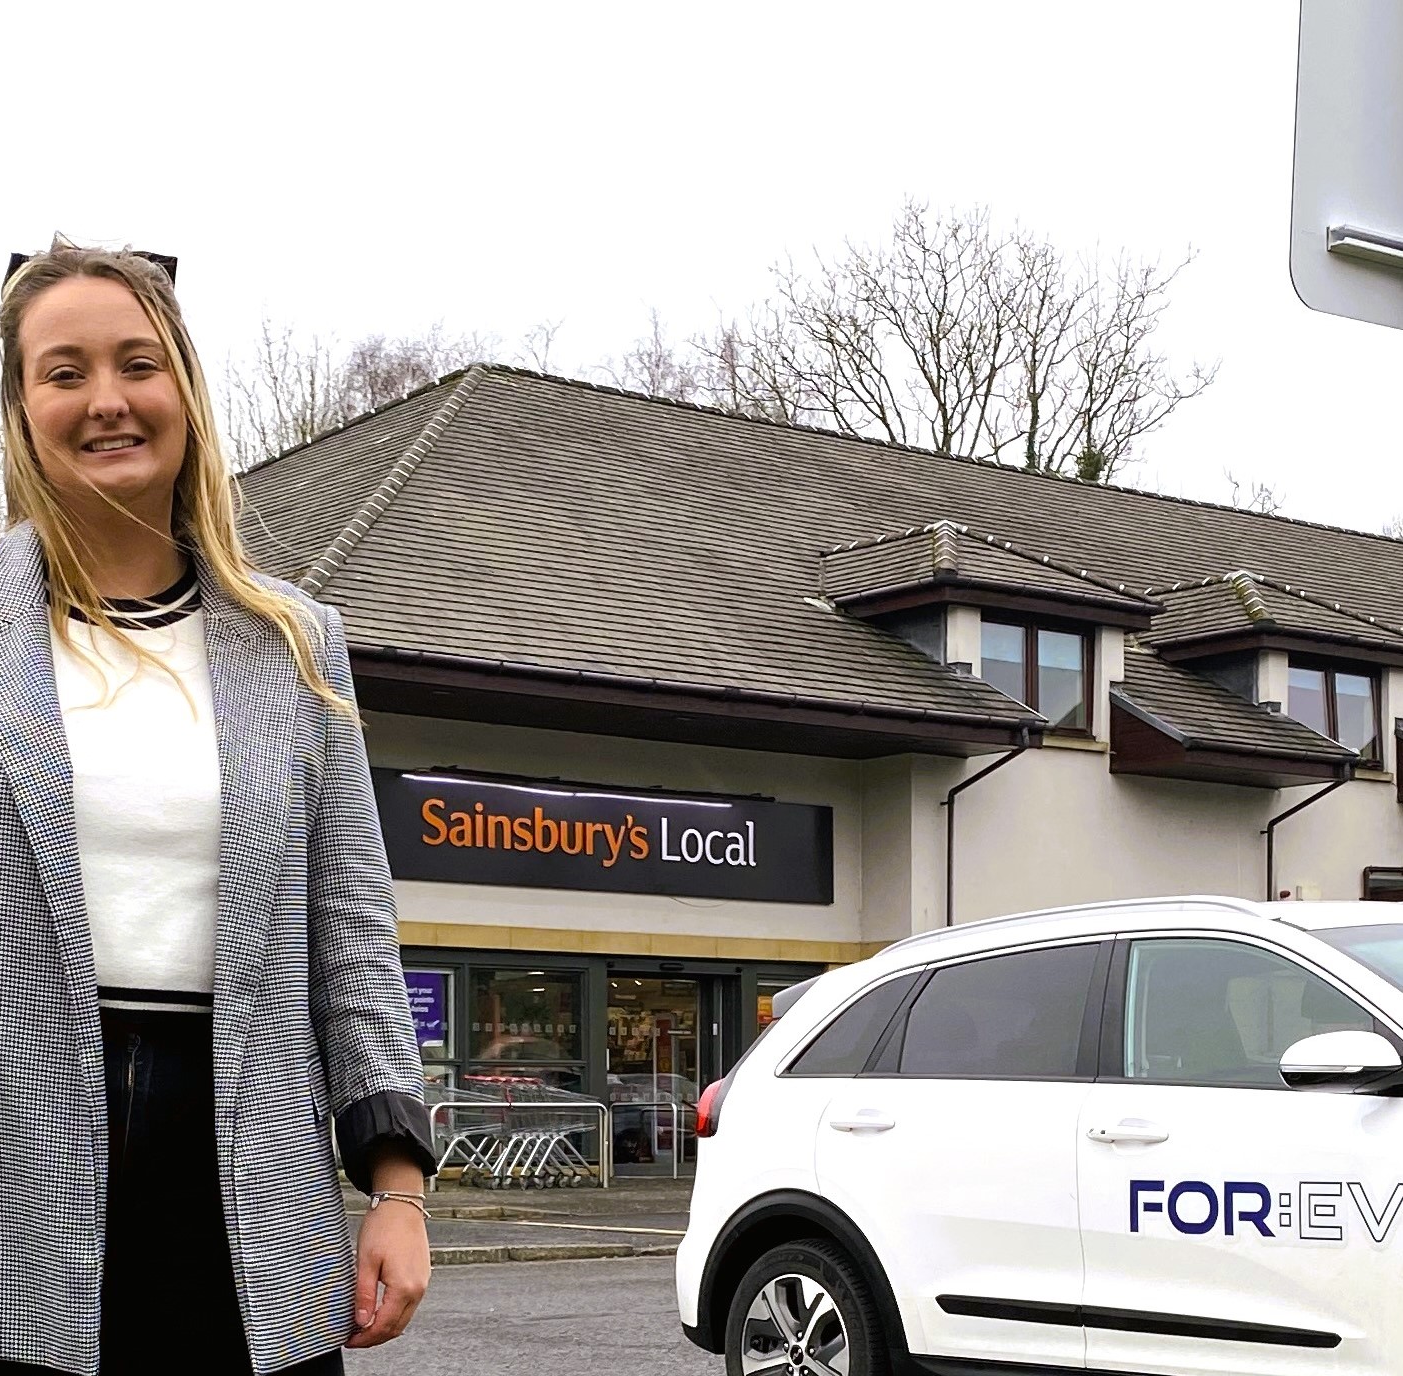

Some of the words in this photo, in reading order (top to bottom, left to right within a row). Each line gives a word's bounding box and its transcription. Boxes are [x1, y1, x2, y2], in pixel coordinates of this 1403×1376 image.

[420, 797, 649, 867] Sainsbury's
[660, 817, 757, 868] Local
[1129, 1179, 1403, 1243] FOR:EV
